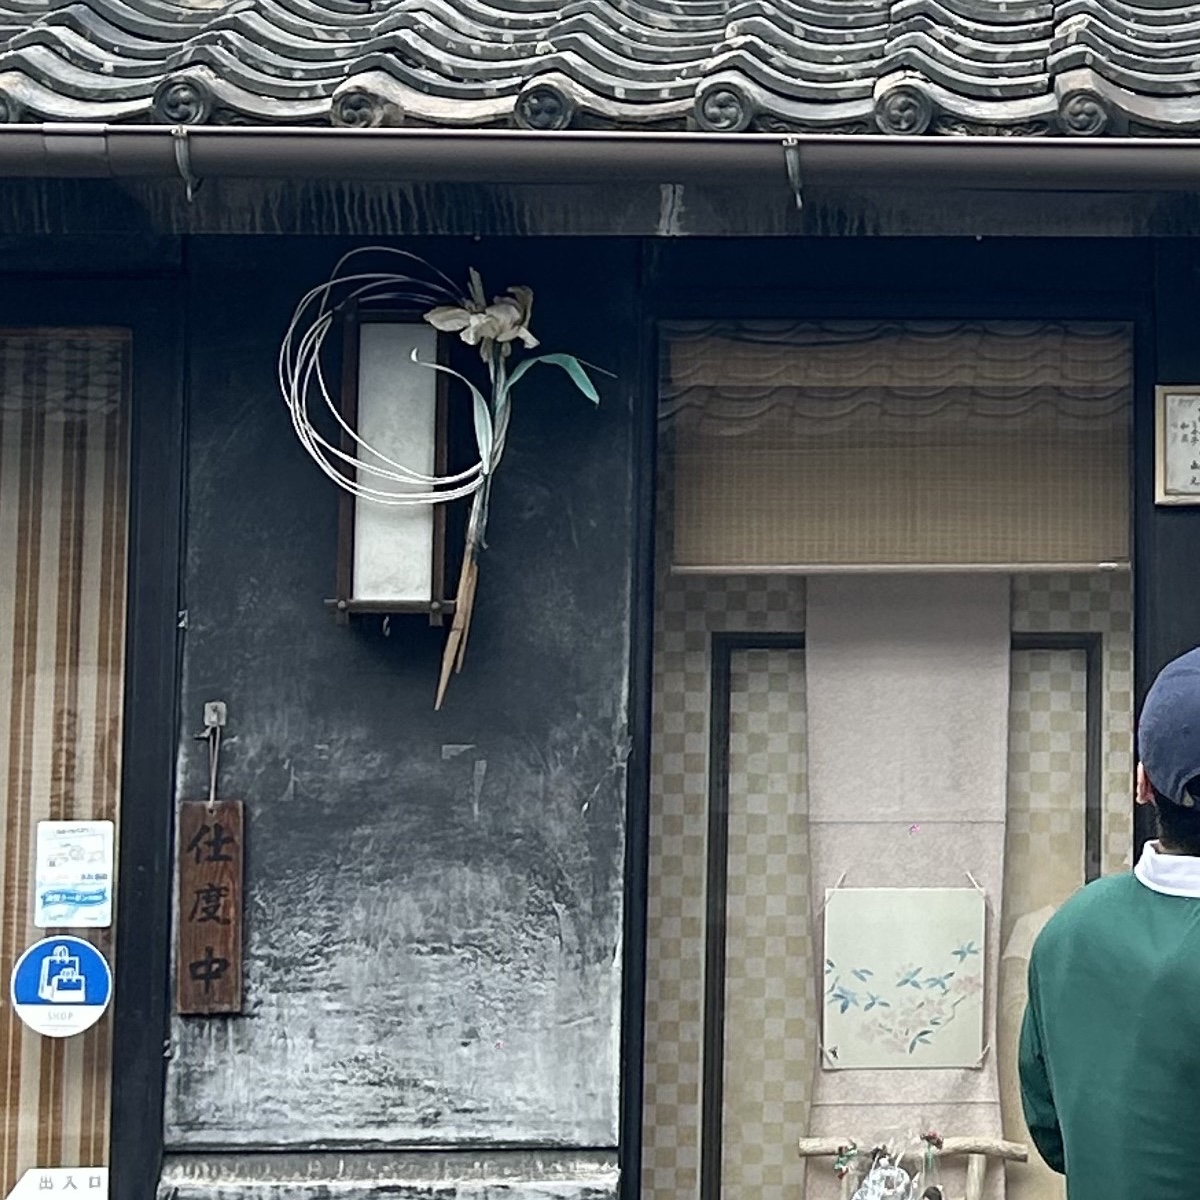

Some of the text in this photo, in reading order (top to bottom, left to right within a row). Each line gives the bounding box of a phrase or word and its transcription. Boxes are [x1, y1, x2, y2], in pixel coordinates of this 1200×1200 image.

[187, 823, 236, 994] 仕度中
[39, 1175, 101, 1191] 出入口
